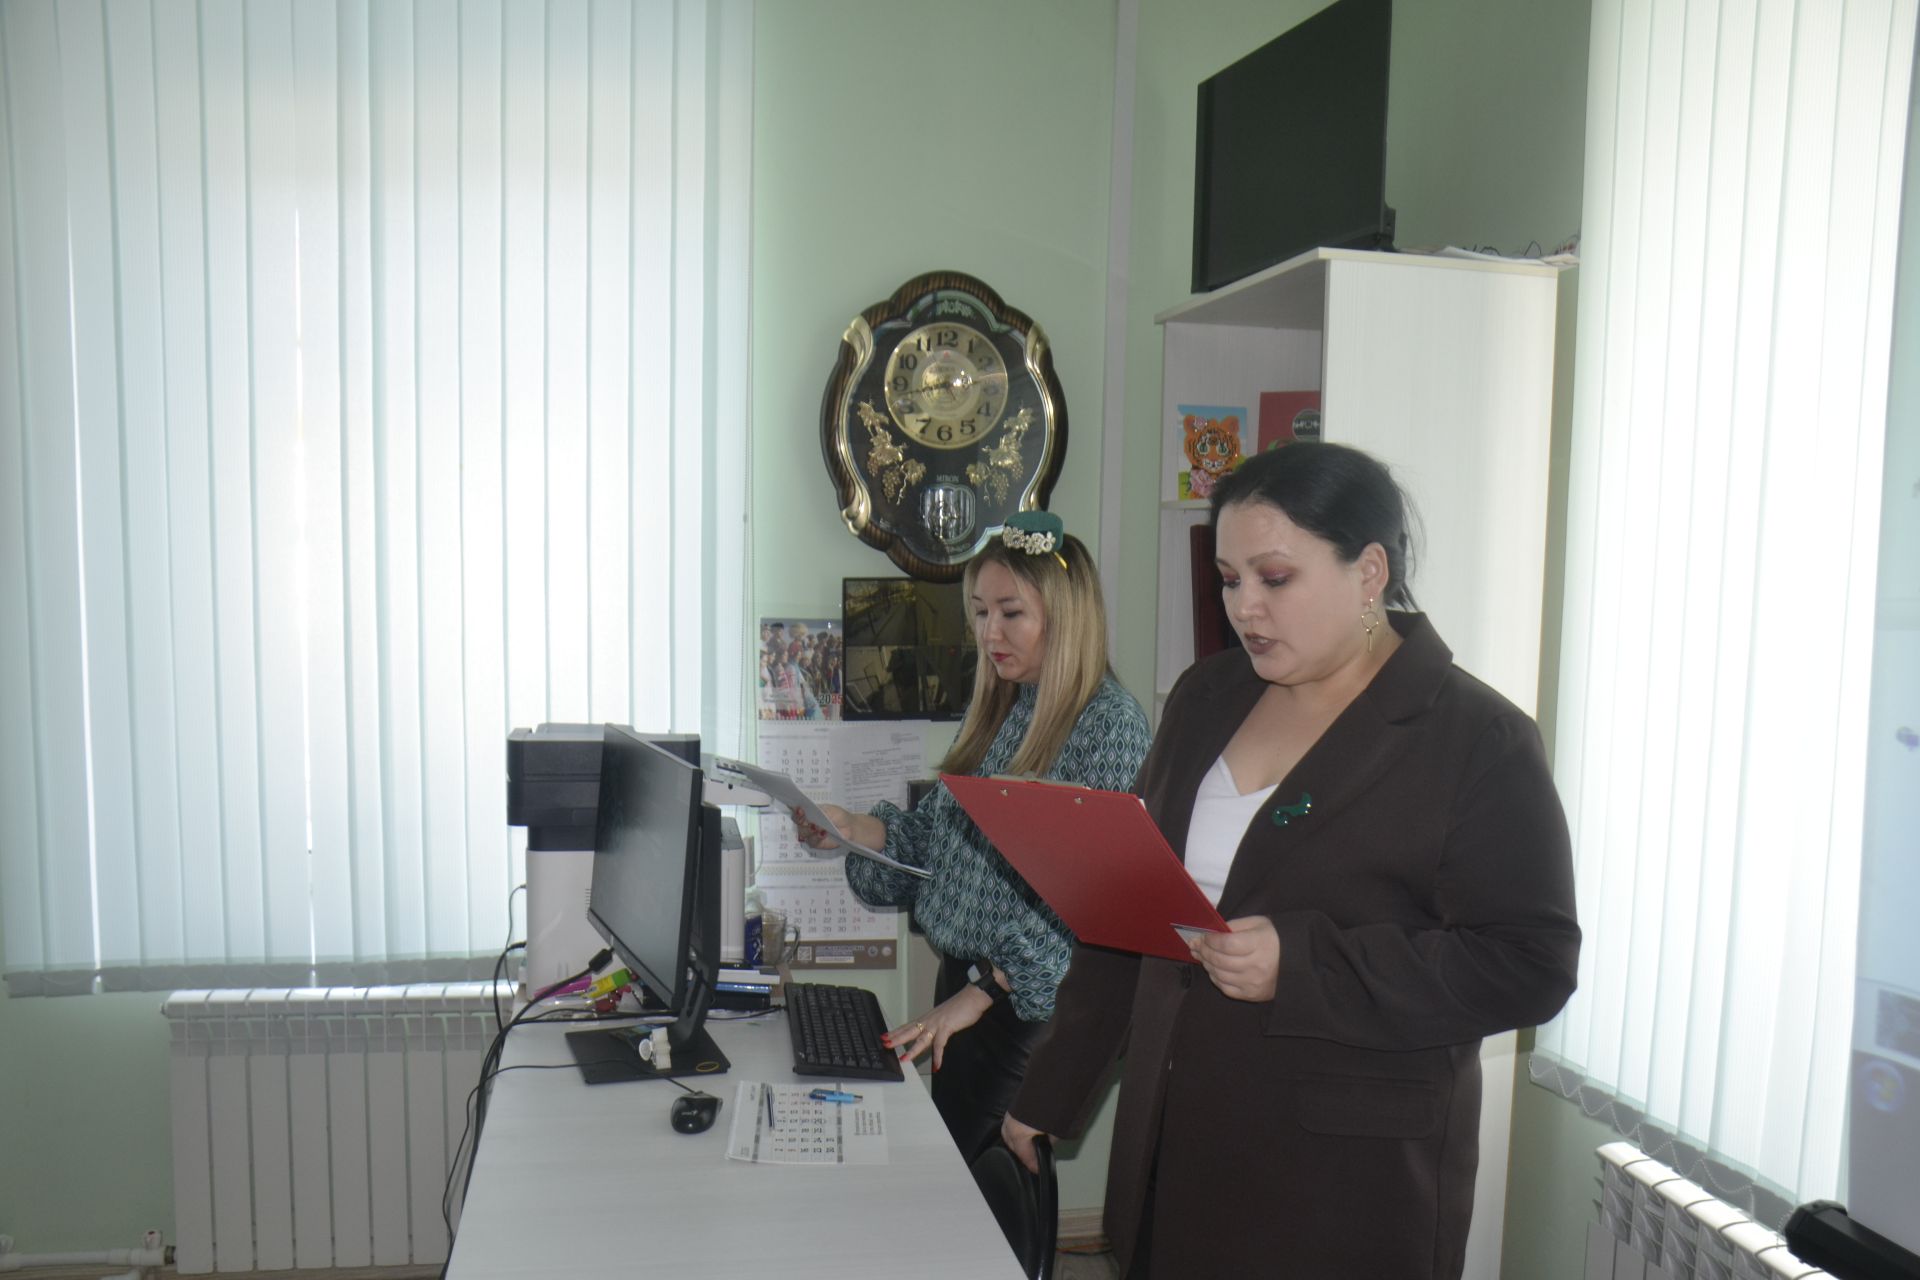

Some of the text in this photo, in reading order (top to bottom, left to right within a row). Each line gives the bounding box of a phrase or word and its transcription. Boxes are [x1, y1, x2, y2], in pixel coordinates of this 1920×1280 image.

[917, 336, 931, 352] 11
[936, 331, 959, 347] 12
[968, 339, 974, 353] 1
[900, 353, 918, 370] 10
[978, 356, 994, 371] 2
[893, 376, 908, 392] 9
[977, 401, 991, 417] 4
[916, 418, 932, 434] 7
[936, 425, 953, 441] 6
[960, 418, 976, 435] 5
